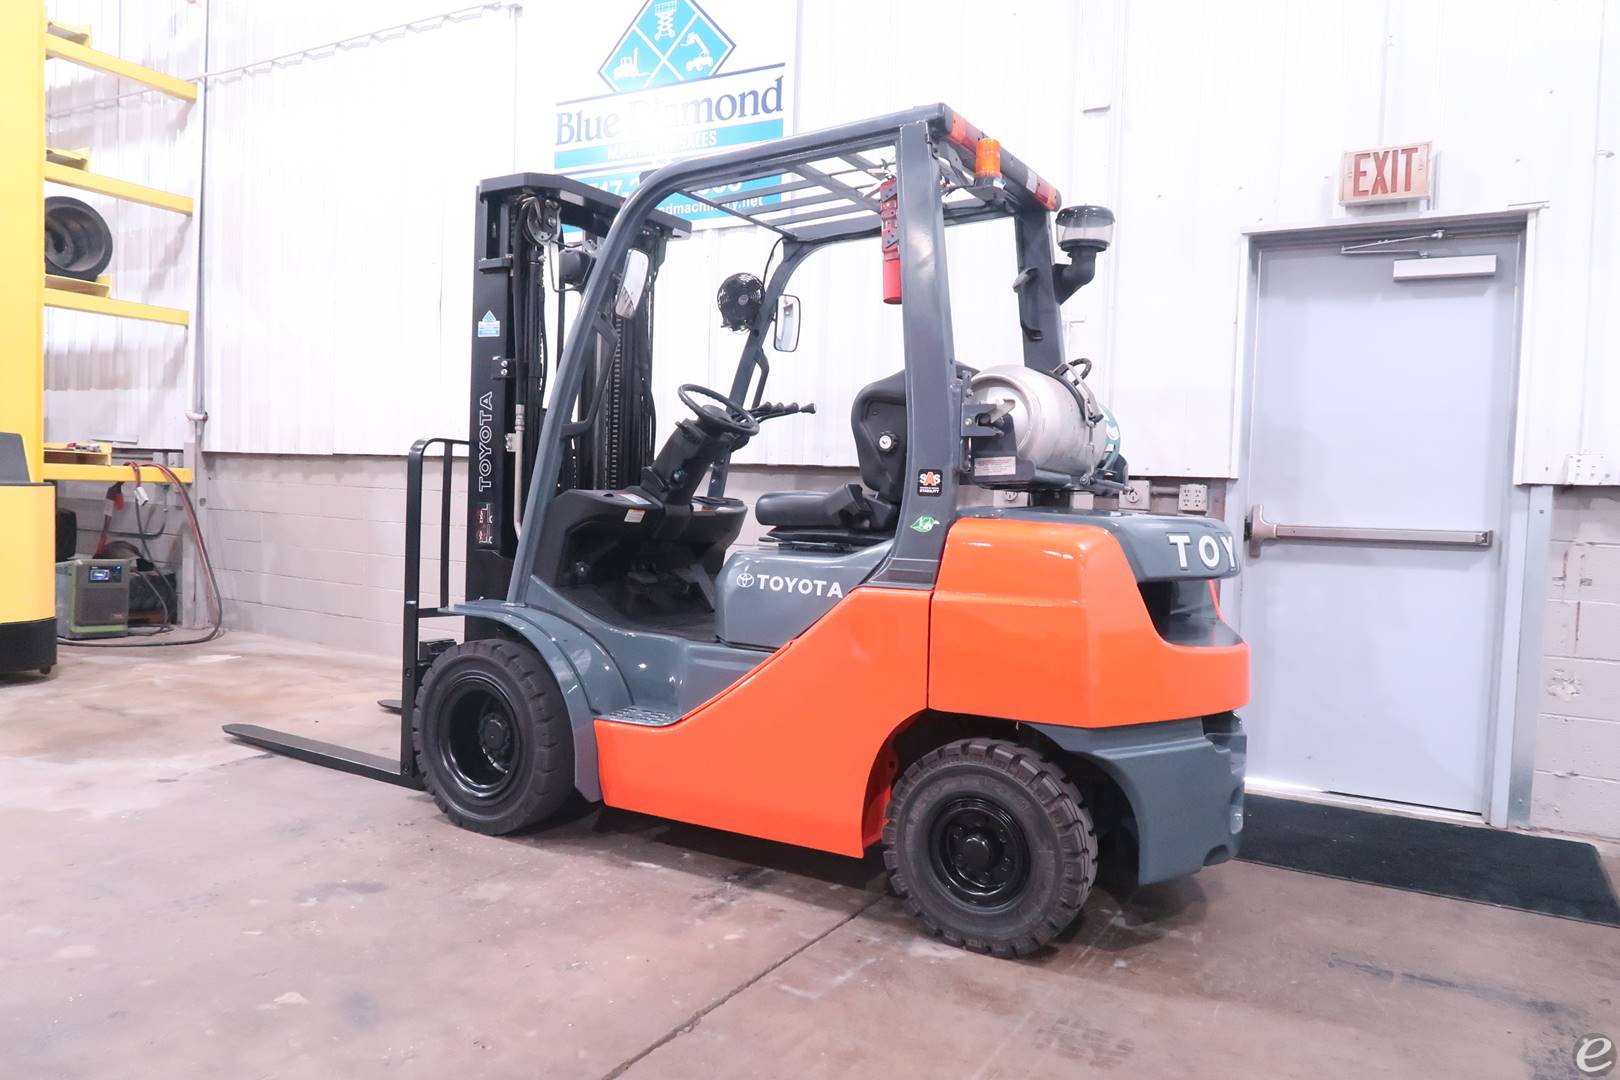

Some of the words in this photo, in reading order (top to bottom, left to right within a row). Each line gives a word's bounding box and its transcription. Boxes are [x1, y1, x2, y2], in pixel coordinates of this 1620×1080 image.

[555, 110, 621, 146] Blue
[679, 130, 718, 150] SALES
[1353, 147, 1418, 197] EXIT
[479, 391, 493, 493] TOYOTA
[919, 471, 941, 487] SAS
[1168, 534, 1236, 568] TOY
[757, 573, 844, 598] TOYOTA
